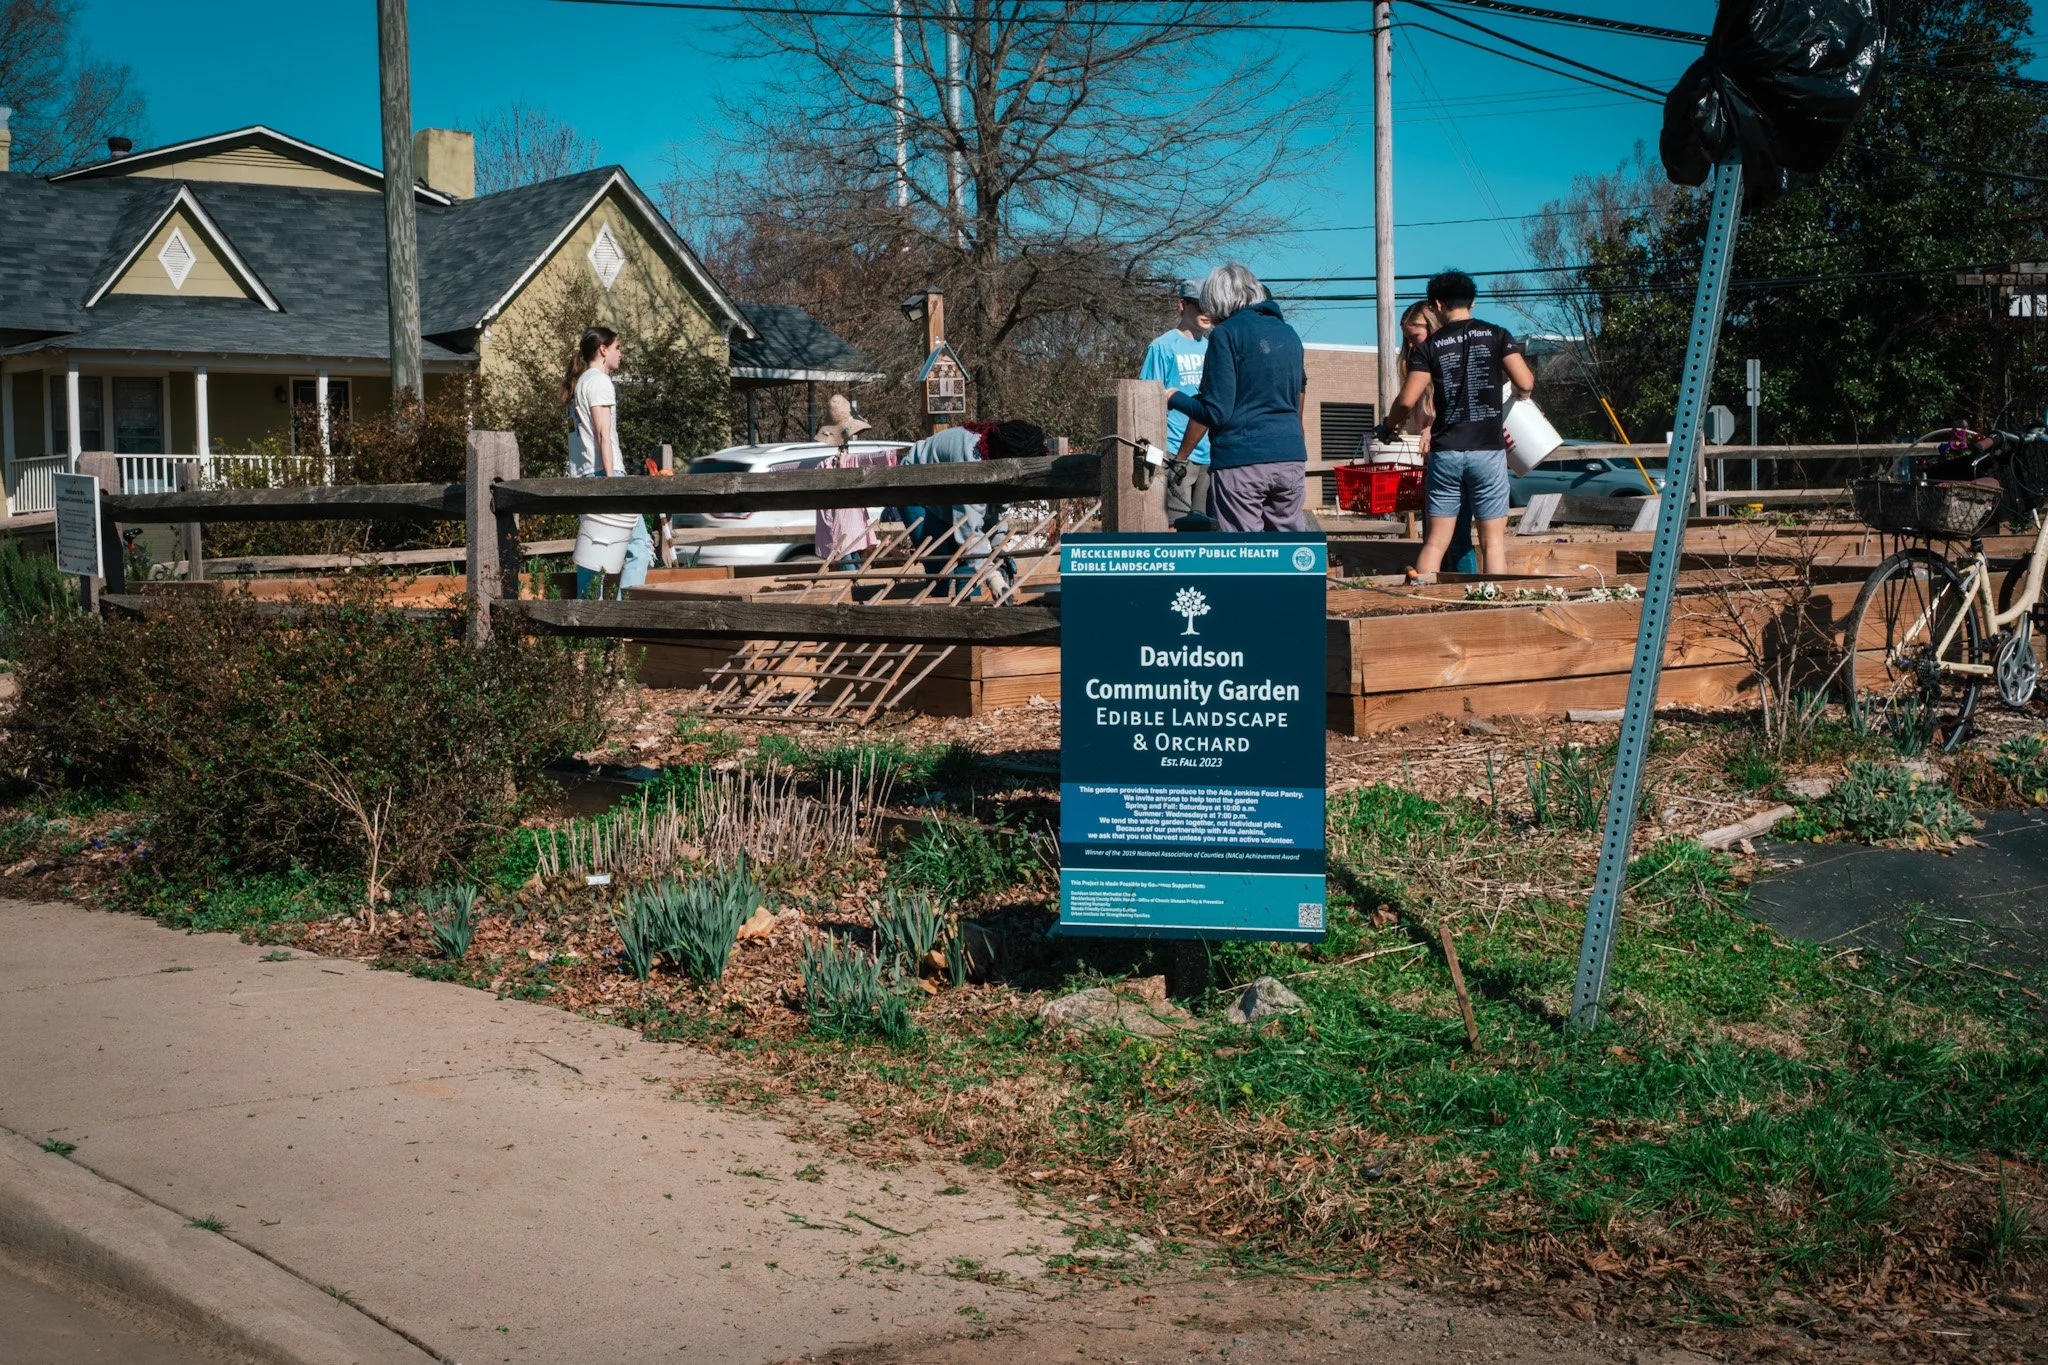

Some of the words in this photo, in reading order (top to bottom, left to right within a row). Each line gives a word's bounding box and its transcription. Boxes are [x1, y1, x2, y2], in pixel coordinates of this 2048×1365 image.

[1435, 336, 1456, 348] Walk
[1176, 354, 1204, 371] NP
[1071, 548, 1150, 558] MECKLENBURG
[1154, 548, 1196, 558] COUNTY
[1198, 548, 1237, 558] PUBLIC
[1240, 548, 1279, 558] HEALTH
[1071, 561, 1106, 571] EDIBLE
[1108, 561, 1176, 572] LANDSCAPES
[1140, 645, 1244, 667] Davidson
[1086, 679, 1212, 705] Community
[1218, 679, 1300, 702] Garden
[1096, 708, 1164, 726] EDIBLE
[1172, 708, 1288, 728] LANDSCAPE
[1133, 734, 1148, 751] &
[1155, 733, 1250, 752] ORCHARD
[1160, 757, 1178, 767] EST.
[1179, 757, 1197, 767] FALL
[1198, 758, 1222, 768] 2023
[1095, 786, 1118, 794] garden
[1120, 787, 1148, 795] provides
[1280, 791, 1304, 799] Pantry.
[1125, 802, 1148, 810] Spring
[1179, 804, 1213, 812] Saturdays
[1186, 820, 1215, 828] together,
[1167, 827, 1206, 835] partnership
